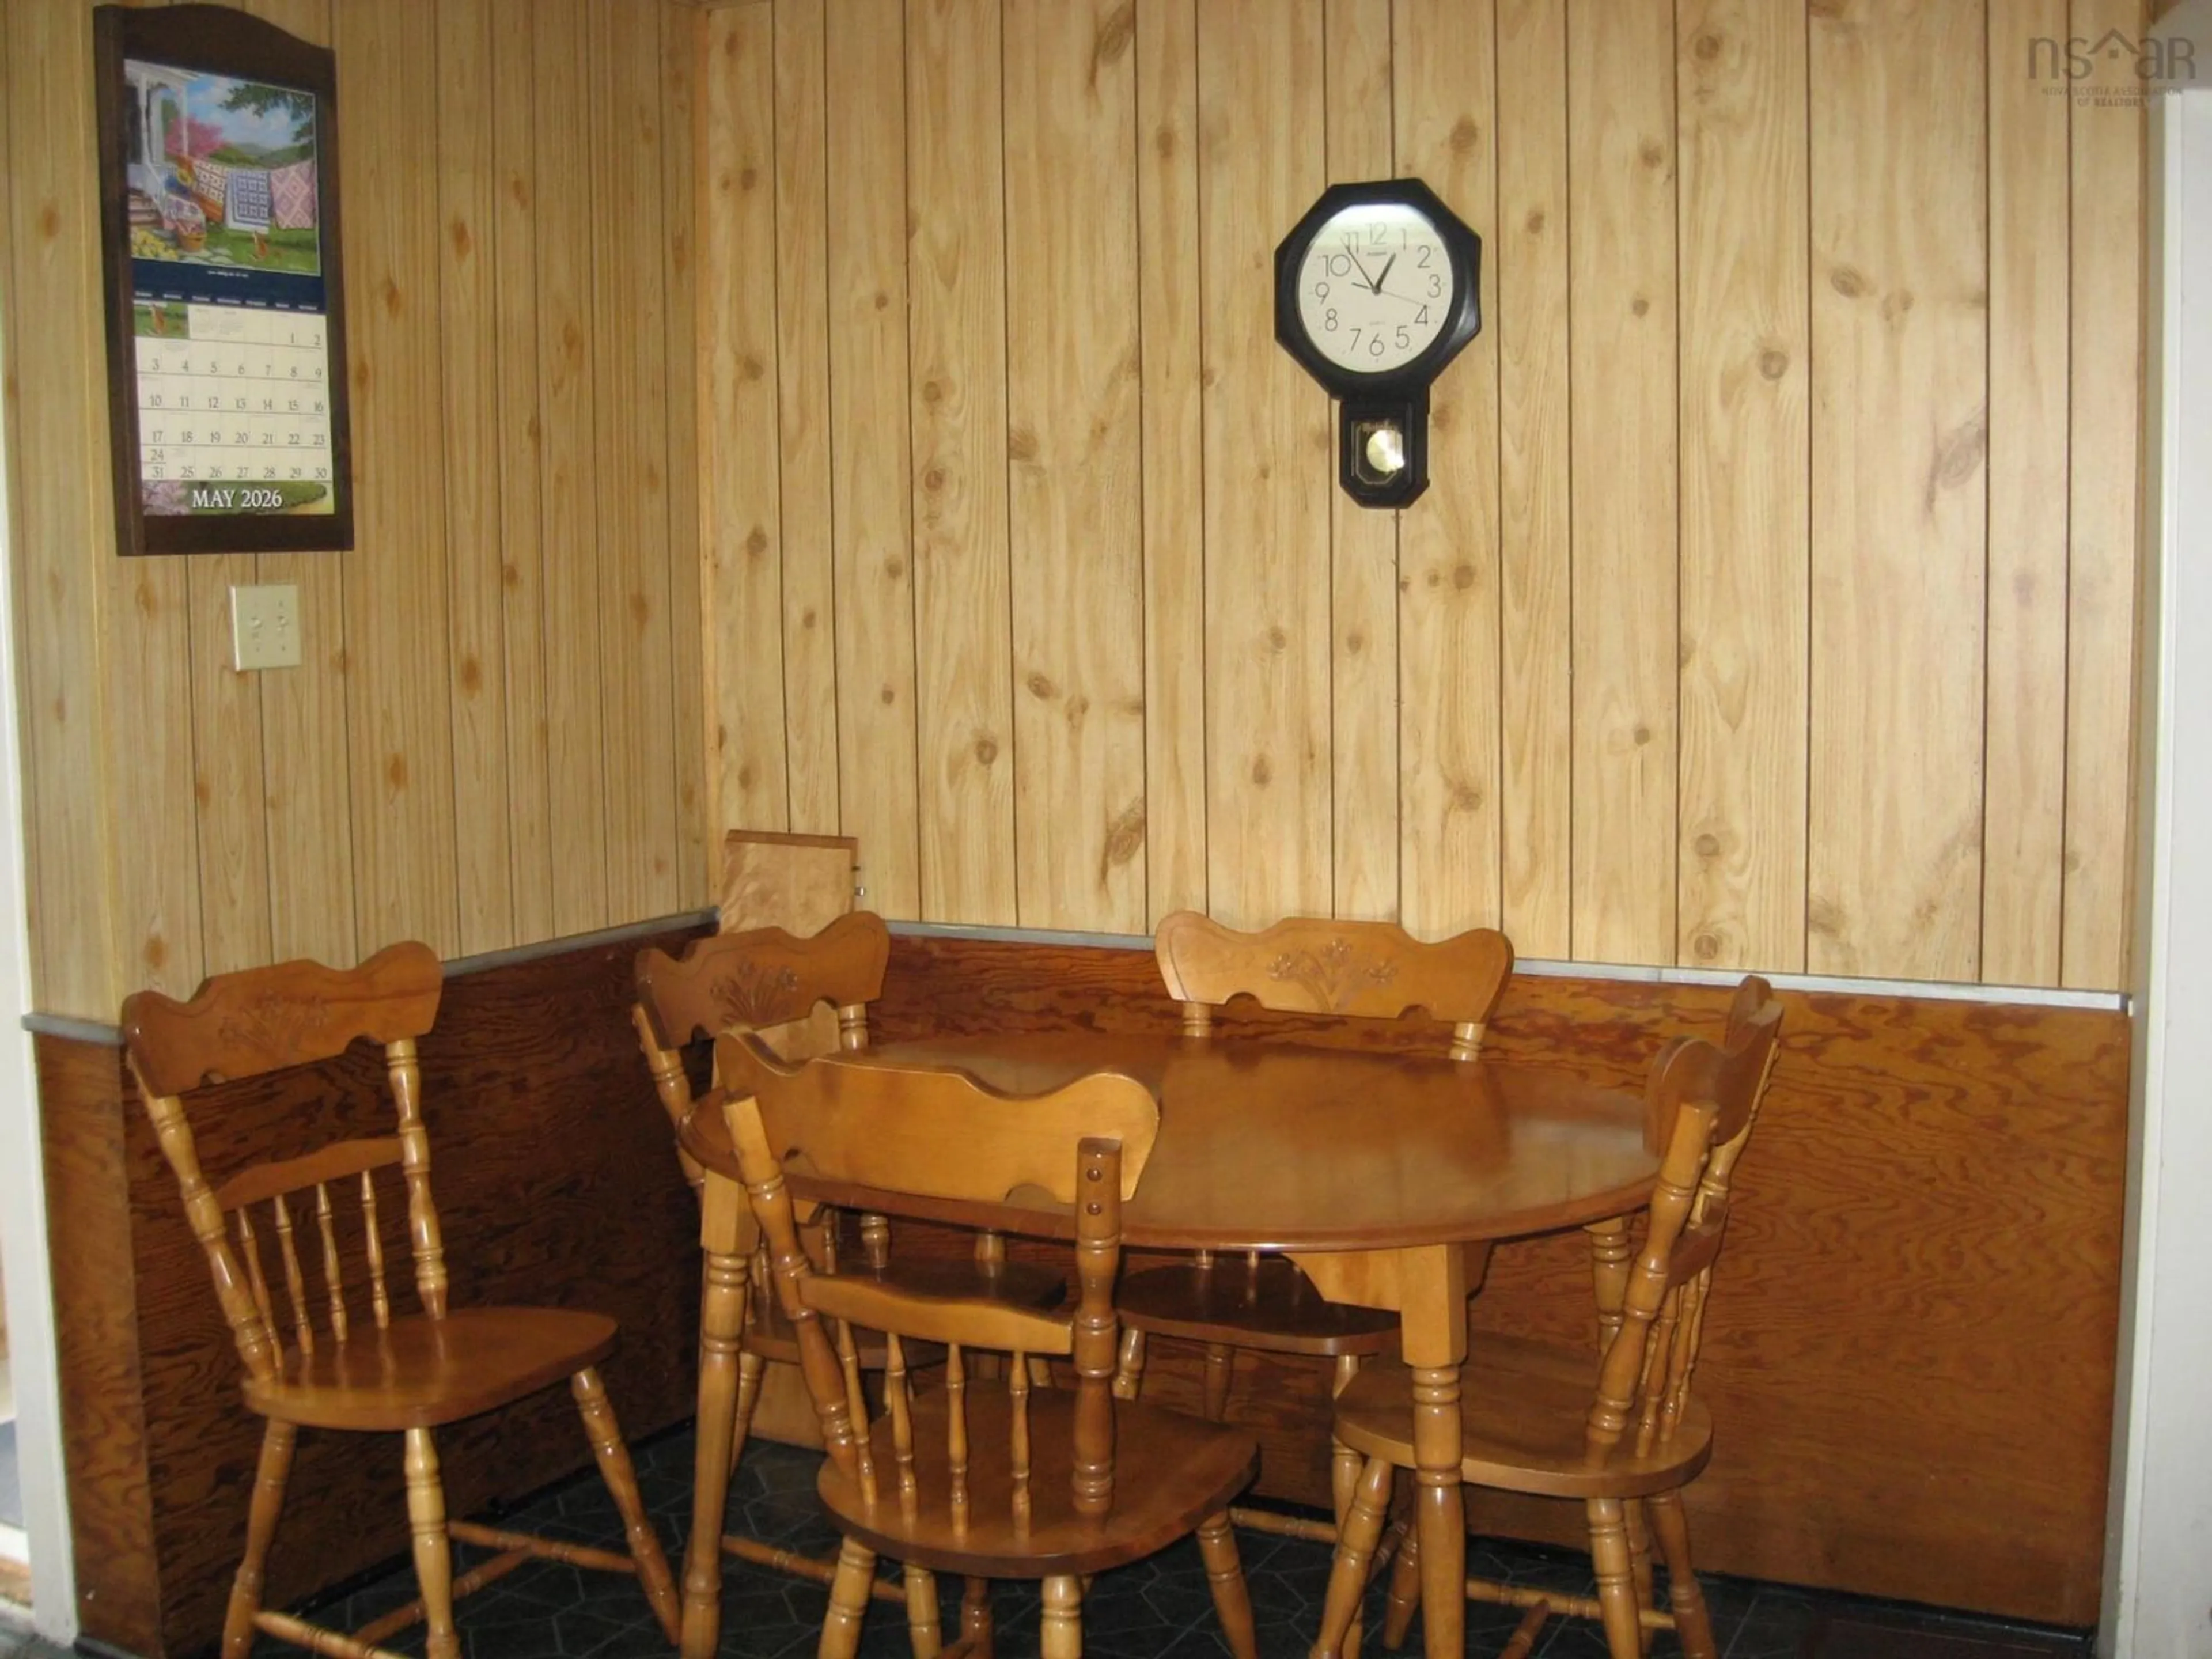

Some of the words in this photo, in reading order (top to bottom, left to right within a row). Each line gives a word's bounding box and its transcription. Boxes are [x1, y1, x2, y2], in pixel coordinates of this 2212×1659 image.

[1344, 232, 1359, 255] 11
[1365, 222, 1387, 244] 12
[1401, 228, 1406, 250] 1
[1321, 254, 1351, 276] 10
[1417, 245, 1431, 268] 2
[1315, 282, 1330, 305] 9
[1427, 274, 1441, 298] 3
[1325, 308, 1338, 331] 8
[1414, 305, 1429, 327] 4
[290, 332, 295, 344] 1
[314, 334, 321, 346] 2
[1350, 328, 1361, 352] 7
[1369, 332, 1385, 356] 6
[1395, 325, 1410, 349] 5
[152, 358, 160, 370] 3
[180, 359, 189, 372] 4
[210, 361, 218, 373] 5
[238, 364, 244, 375] 6
[266, 365, 271, 376] 7
[290, 366, 298, 378] 8
[315, 368, 322, 378] 9
[150, 394, 162, 407] 10
[180, 396, 189, 407] 11
[208, 396, 219, 408] 12
[235, 398, 246, 410] 13
[263, 399, 272, 410] 14
[289, 400, 299, 411] 15
[314, 401, 324, 412] 16
[152, 431, 163, 443] 17
[181, 431, 194, 443] 18
[210, 431, 221, 443] 19
[235, 432, 248, 444] 20
[262, 433, 273, 444] 21
[288, 433, 300, 444] 22
[313, 434, 325, 445] 23
[150, 448, 164, 461] 24
[151, 466, 164, 478] 31
[180, 465, 194, 478] 25
[209, 465, 222, 478] 26
[237, 466, 249, 479] 27
[263, 467, 276, 479] 28
[290, 467, 301, 479] 29
[315, 467, 327, 479] 30
[192, 490, 236, 508] MAY
[241, 489, 283, 508] 2026
